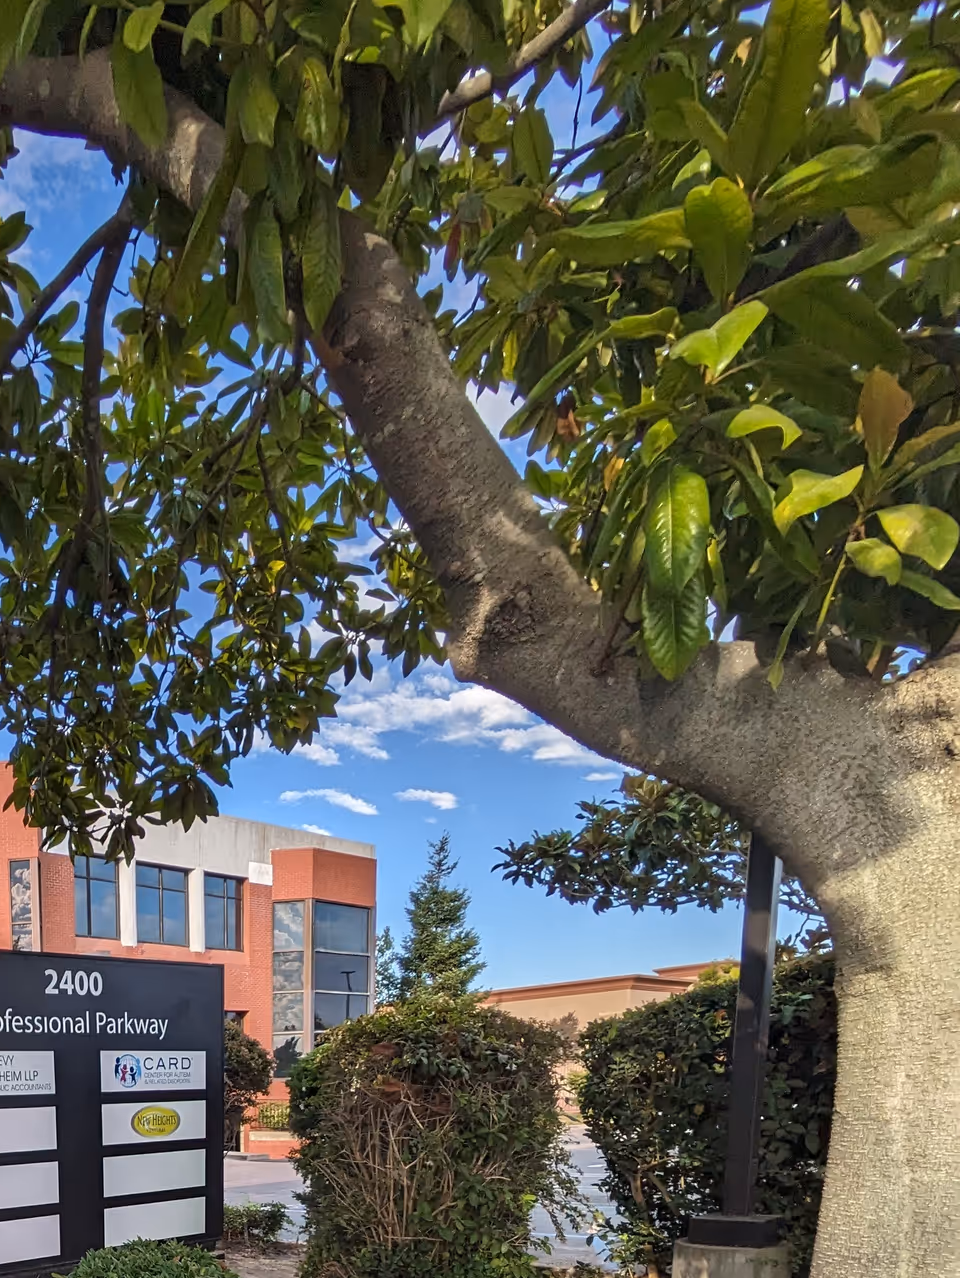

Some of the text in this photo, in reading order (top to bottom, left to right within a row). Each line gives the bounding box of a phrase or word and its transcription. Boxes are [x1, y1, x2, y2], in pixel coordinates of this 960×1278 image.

[44, 968, 103, 997] 2400
[96, 1011, 169, 1040] Parkway
[143, 1057, 192, 1071] CARD
[24, 1070, 39, 1081] LLP
[11, 1083, 52, 1092] ACCOUNTANTS
